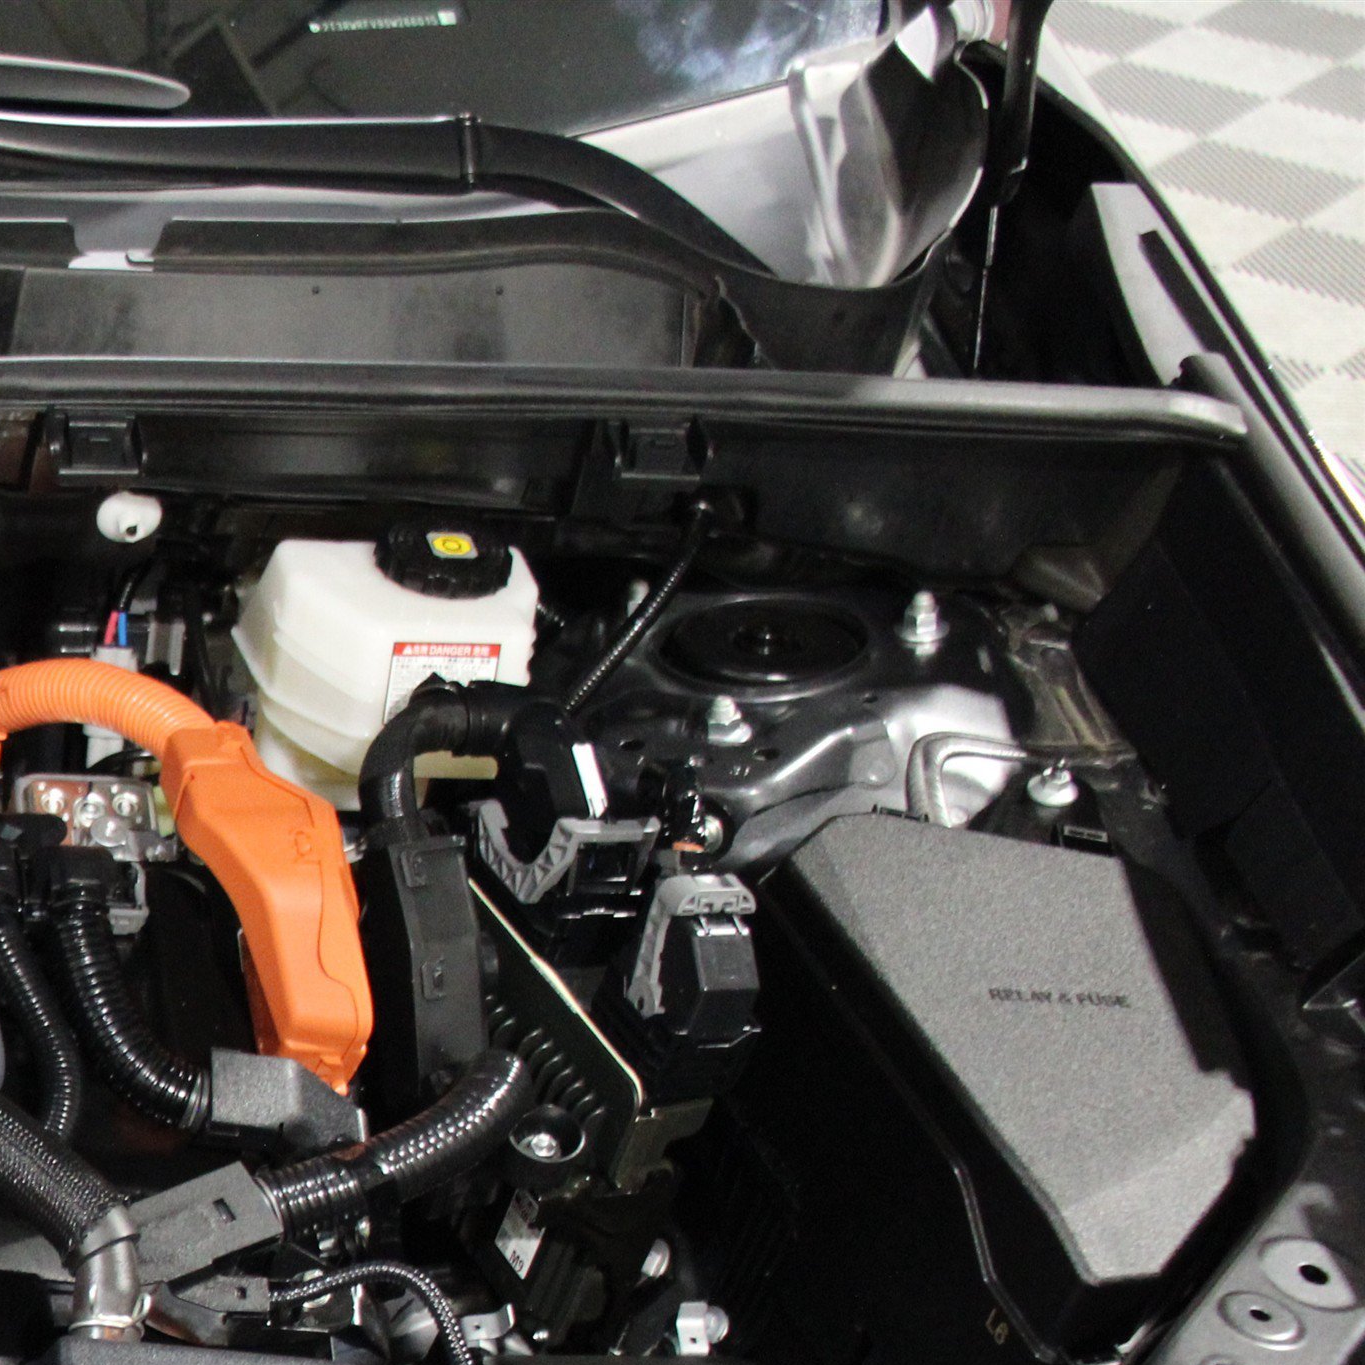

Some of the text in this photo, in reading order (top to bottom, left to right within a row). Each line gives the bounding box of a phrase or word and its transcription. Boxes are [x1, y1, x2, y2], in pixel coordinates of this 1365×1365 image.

[429, 645, 472, 657] DANGER
[988, 987, 1053, 1004] RELAY
[1075, 991, 1132, 1009] FUSE
